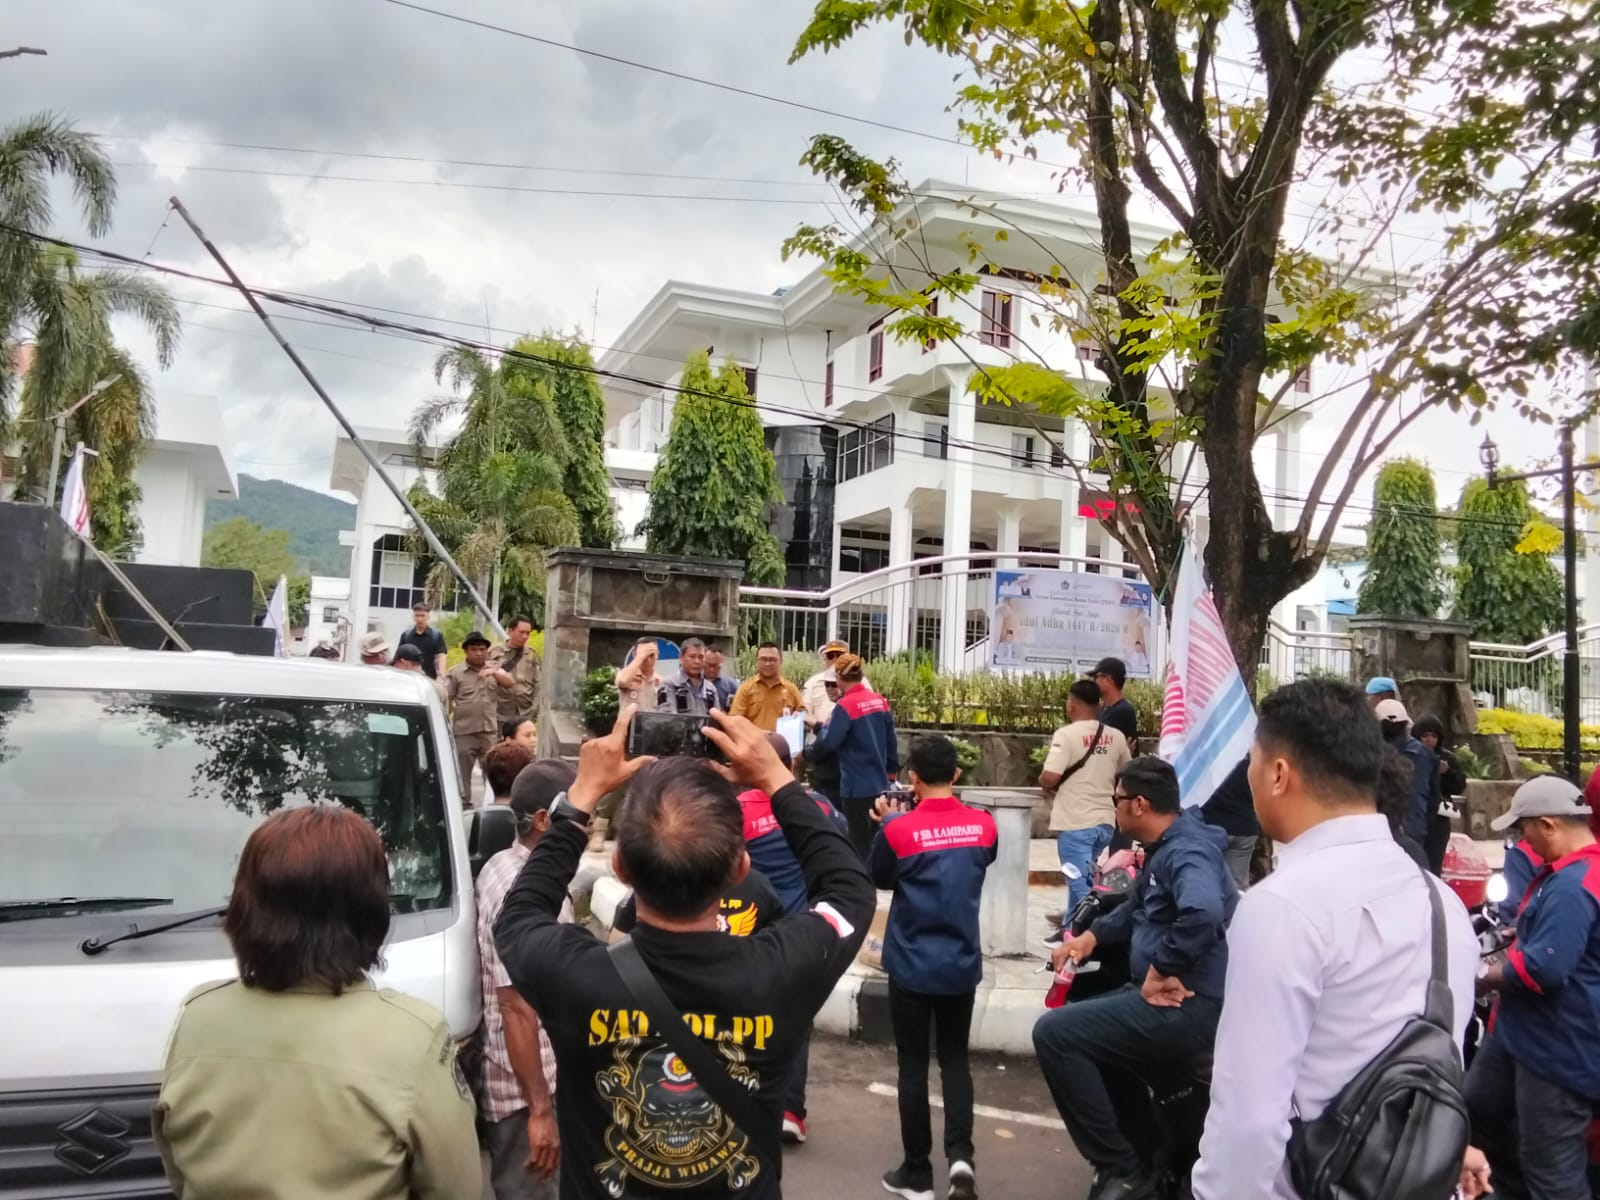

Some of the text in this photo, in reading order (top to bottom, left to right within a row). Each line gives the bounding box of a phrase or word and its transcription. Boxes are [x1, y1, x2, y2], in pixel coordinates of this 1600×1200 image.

[588, 1009, 773, 1050] SATOL PP
[677, 1140, 738, 1178] WIBAWA
